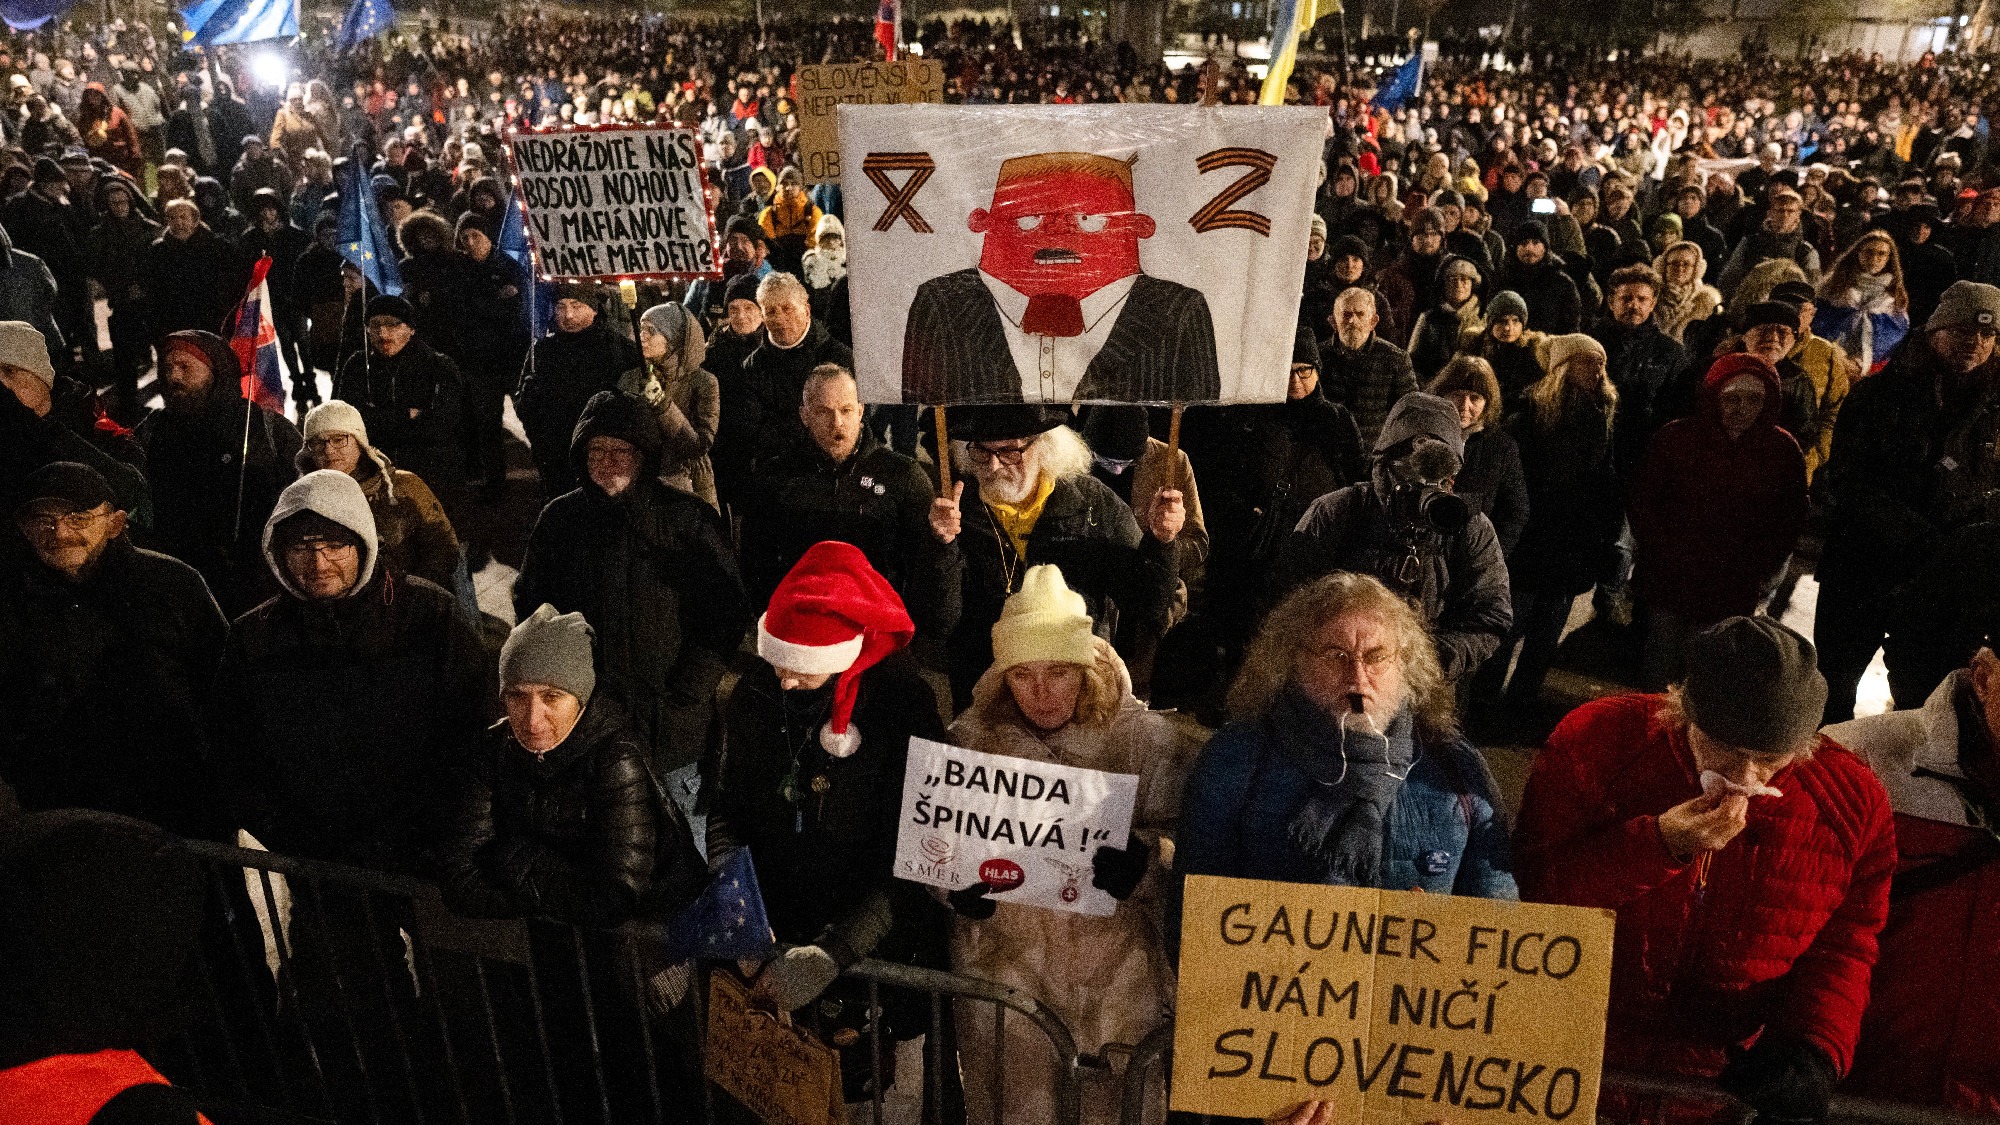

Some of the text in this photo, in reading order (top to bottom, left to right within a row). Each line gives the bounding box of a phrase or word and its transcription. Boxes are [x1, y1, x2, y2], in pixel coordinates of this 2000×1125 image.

[513, 132, 696, 172] NEDRÁŽDITE NÁS
[522, 175, 593, 209] BOSOU
[602, 171, 679, 205] NOHOU
[531, 207, 690, 243] V MAFIÁNOVE
[541, 238, 713, 276] MÁME MAŤ DETI?
[924, 758, 1070, 805] „BANDA
[912, 792, 1066, 850] ŠPINAVÁ
[904, 860, 961, 885] SMER
[984, 867, 1020, 881] HLAS
[1220, 903, 1583, 980] GAUNER FICO
[1239, 961, 1509, 1035] NÁM NIČÍ
[1207, 1028, 1581, 1122] SLOVENSKO
